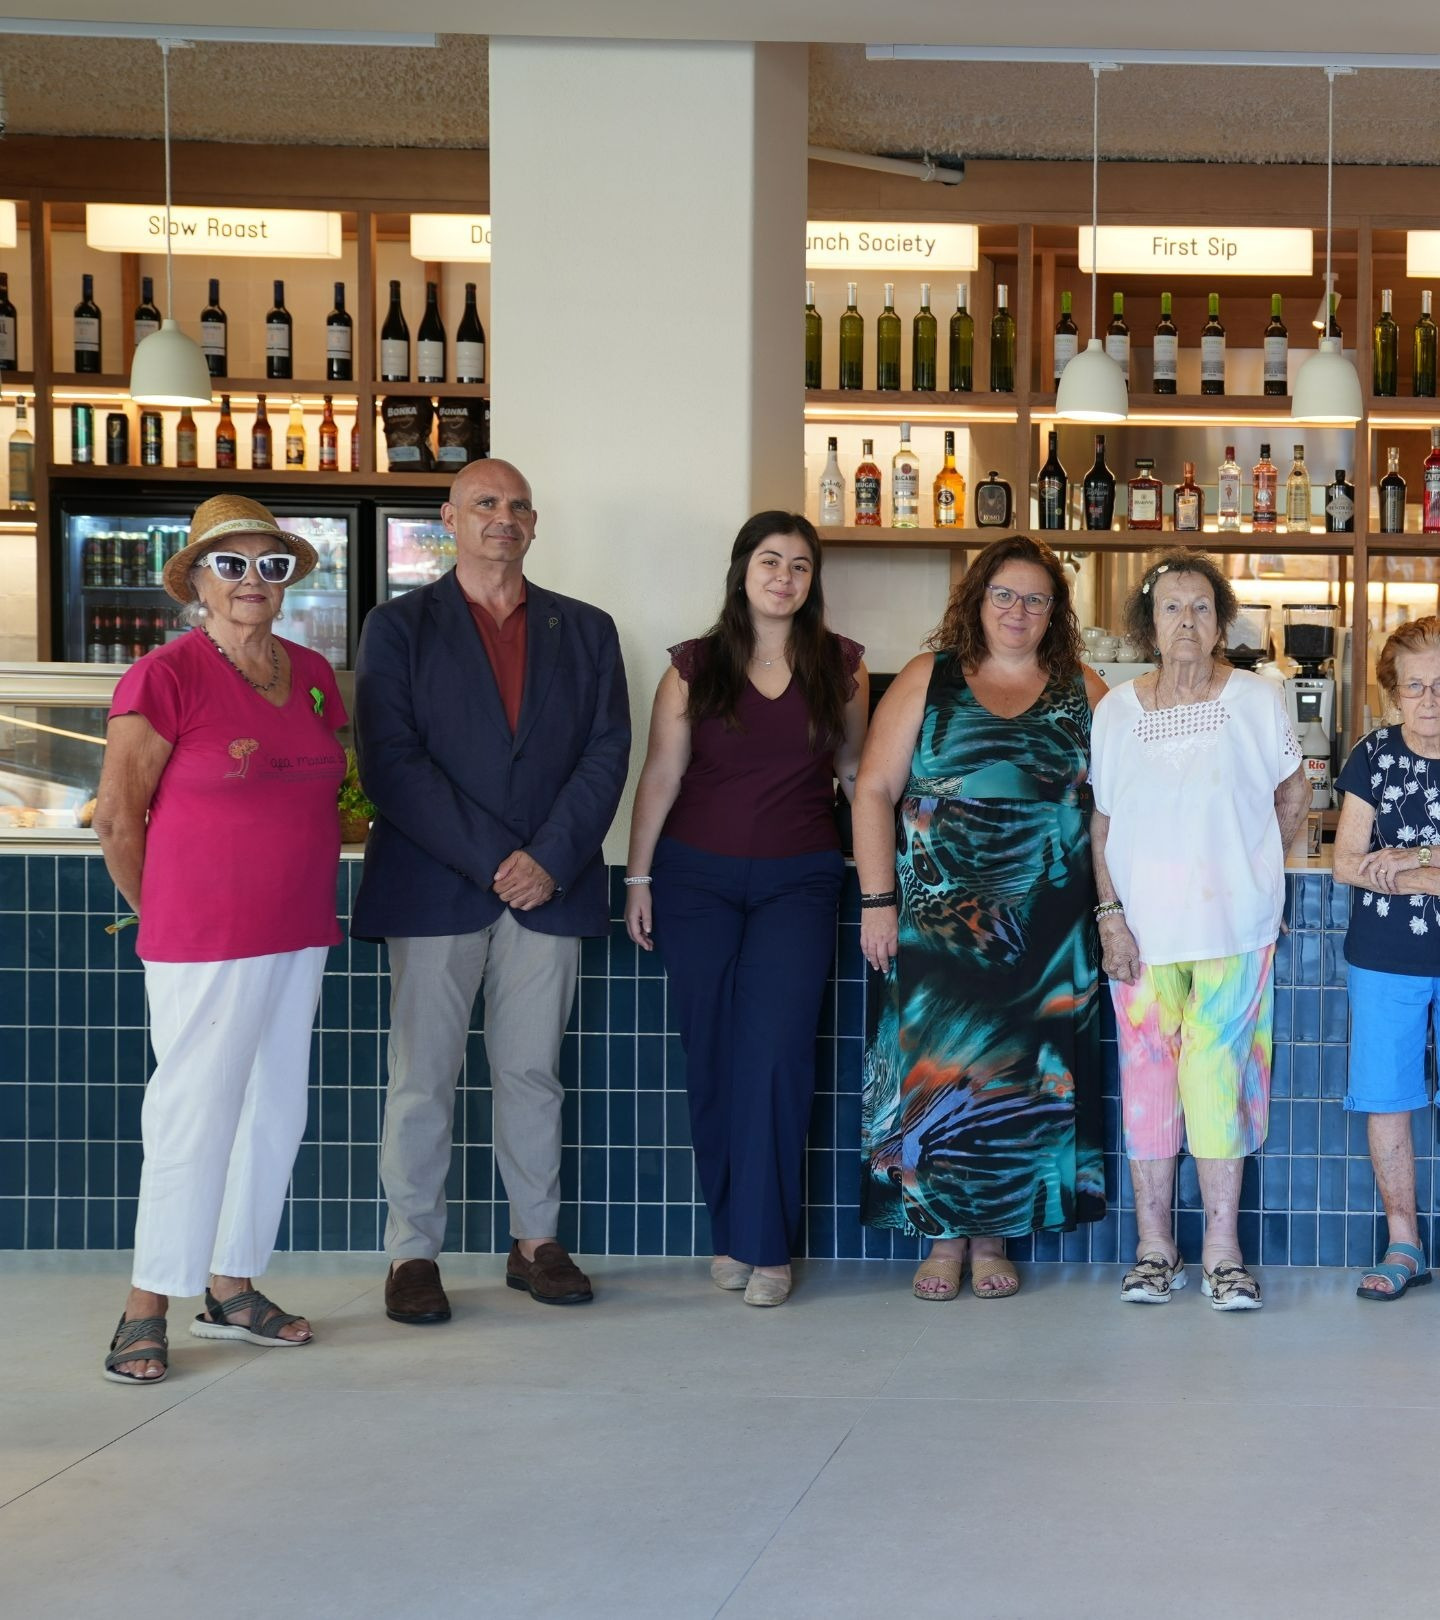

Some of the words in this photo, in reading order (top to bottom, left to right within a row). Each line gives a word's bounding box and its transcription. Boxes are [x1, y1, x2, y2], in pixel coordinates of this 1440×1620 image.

[148, 215, 197, 236] Slow
[208, 217, 268, 239] Roast
[858, 232, 936, 257] Society
[1152, 236, 1198, 256] First
[1208, 237, 1238, 262] Sip
[387, 406, 418, 417] BONKA
[439, 407, 468, 417] BONKA
